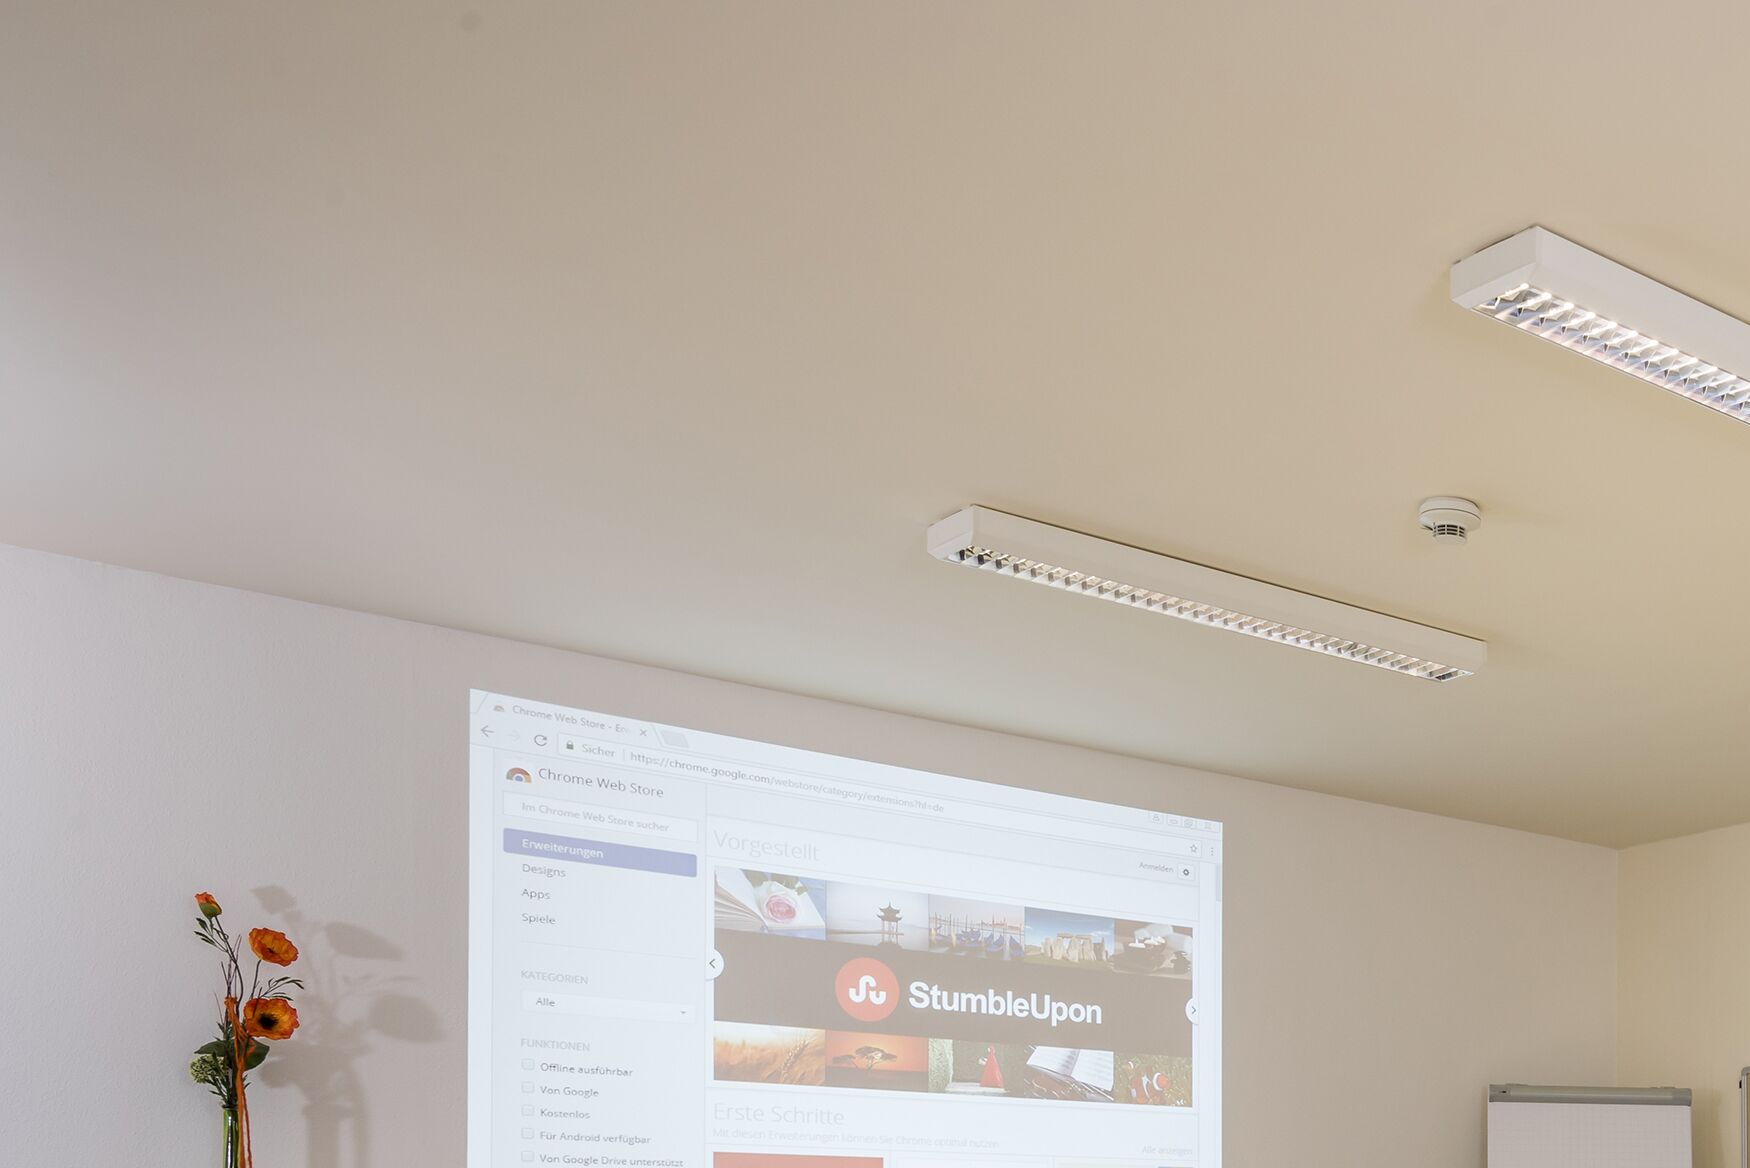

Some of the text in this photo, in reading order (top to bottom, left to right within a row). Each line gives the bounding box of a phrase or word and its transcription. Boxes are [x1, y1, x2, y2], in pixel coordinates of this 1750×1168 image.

[512, 705, 553, 720] Chrome
[554, 712, 577, 725] Web
[580, 718, 605, 730] Store
[582, 743, 615, 757] Sicher
[538, 768, 664, 798] Chrome Web Store
[539, 804, 579, 819] Chrome
[583, 810, 604, 823] Web
[608, 814, 634, 827] Store
[522, 839, 604, 859] Erweiterungen
[713, 830, 819, 861] Vorgestellt
[522, 863, 567, 878] Designs
[1139, 861, 1174, 873] Anmelden
[521, 888, 551, 902] Apps
[521, 912, 556, 925] Spiele
[521, 970, 589, 984] KATEGORIEN
[536, 997, 556, 1008] Alle
[909, 981, 1102, 1026] StumbleUpon
[520, 1038, 590, 1052] FUNKTIONEN
[540, 1062, 633, 1077] Offline ausführbar
[540, 1085, 599, 1099] Von Google
[540, 1108, 591, 1119] Kostenlos
[713, 1101, 846, 1127] Erste Schritte
[540, 1130, 651, 1146] Für Android verfügbar
[713, 1127, 729, 1138] Mit
[540, 1154, 560, 1164] Von
[563, 1155, 599, 1166] Google
[601, 1156, 627, 1167] Drive
